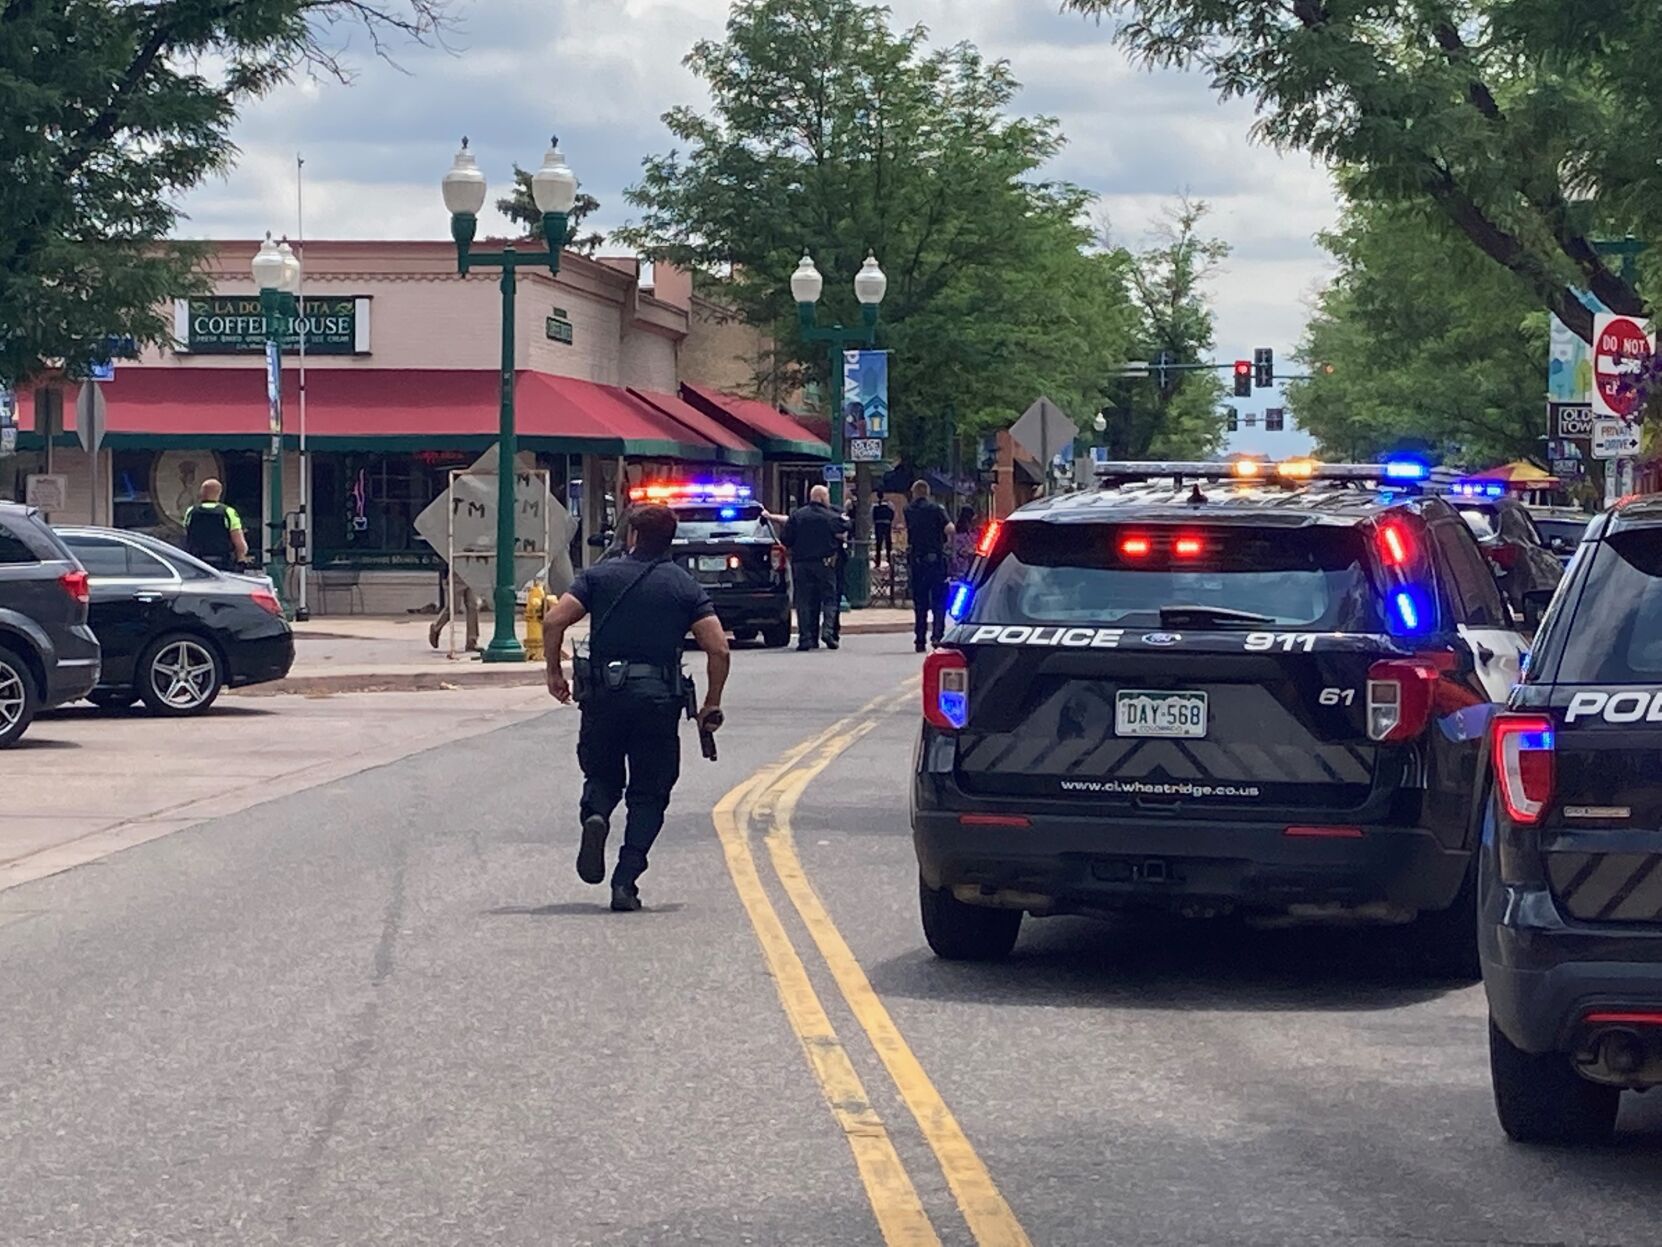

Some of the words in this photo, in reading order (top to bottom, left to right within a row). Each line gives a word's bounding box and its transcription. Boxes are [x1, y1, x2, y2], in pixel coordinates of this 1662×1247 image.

[215, 302, 234, 314] LA
[1602, 335, 1618, 351] DO
[1623, 337, 1646, 355] NOT
[843, 349, 860, 402] PLAY
[1563, 408, 1592, 421] OLD
[1562, 421, 1593, 433] TOW
[452, 498, 485, 518] TM
[969, 625, 1125, 648] POLICE
[1243, 631, 1317, 652] 911
[1319, 687, 1356, 706] 61
[1060, 780, 1260, 797] www.ci.wheatridge.co.us
